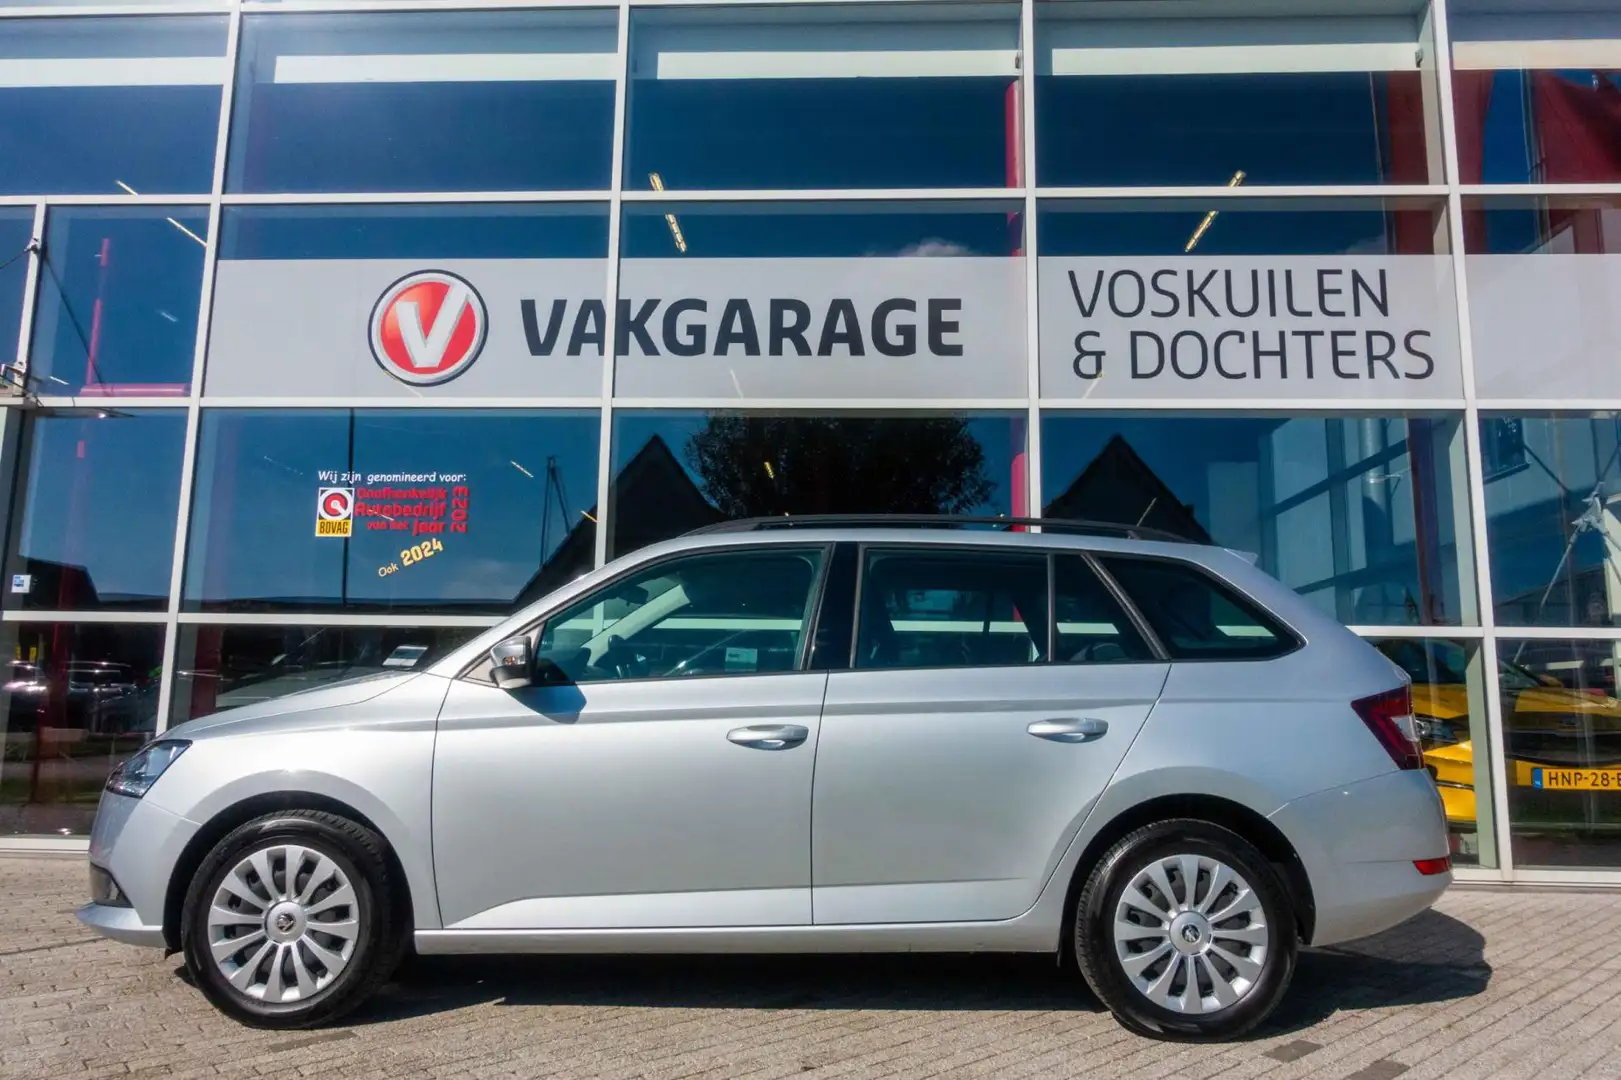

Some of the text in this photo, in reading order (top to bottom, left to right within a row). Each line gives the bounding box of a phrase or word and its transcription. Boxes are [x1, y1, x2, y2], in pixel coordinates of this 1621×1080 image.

[1068, 269, 1389, 318] VOSKUILEN
[395, 282, 471, 368] V
[520, 298, 964, 357] VAKGARAGE
[1072, 330, 1435, 379] & DOCHTERS
[318, 471, 467, 484] Wij zijn genomineerd voor:
[319, 521, 349, 534] BOVAG
[354, 502, 446, 519] Autobedrijf
[451, 486, 469, 533] 2023
[378, 538, 443, 577] Ook 2024
